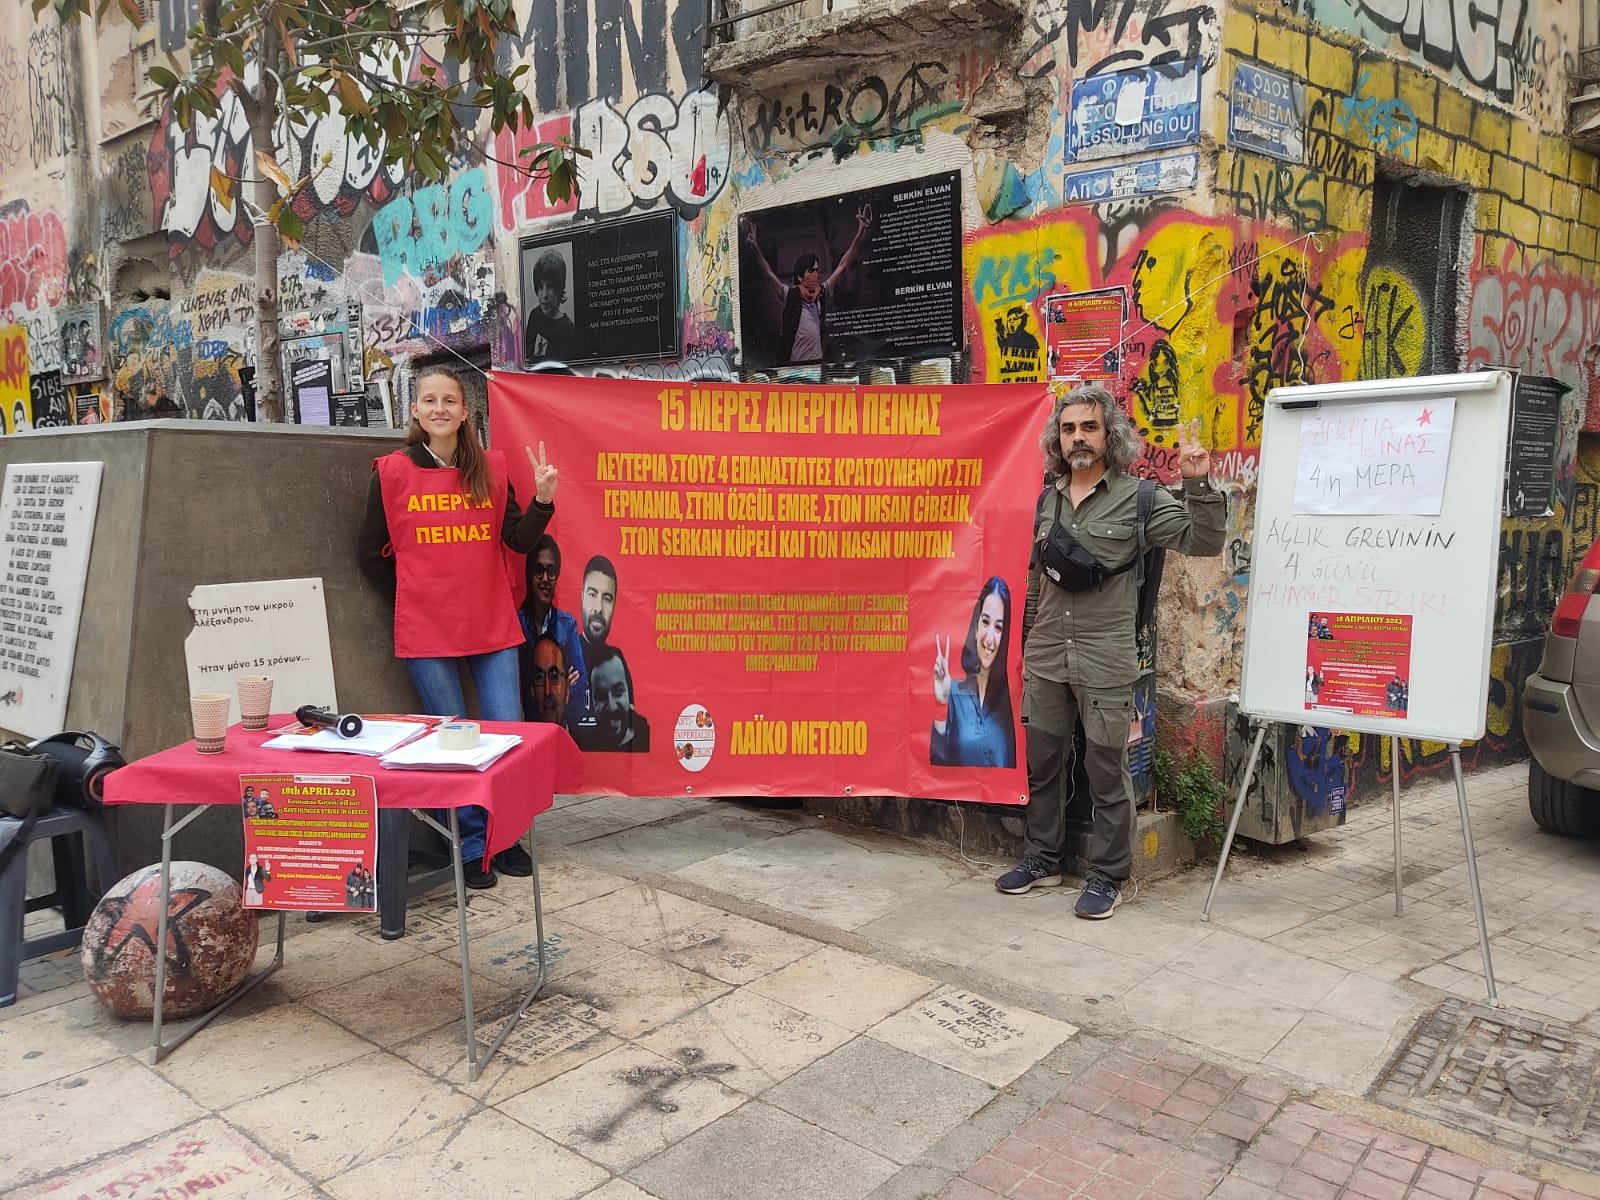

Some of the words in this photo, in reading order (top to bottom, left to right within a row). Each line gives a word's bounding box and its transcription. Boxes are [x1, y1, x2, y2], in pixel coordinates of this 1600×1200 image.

[1253, 73, 1290, 100] ΟΔΟΣ
[1070, 115, 1191, 148] MESSOLONGIOU
[924, 184, 951, 196] ELVAN
[895, 284, 924, 296] BERKİN
[926, 281, 952, 292] ELVAN
[658, 388, 684, 430] 15
[690, 390, 762, 433] ΜΕΡΕΣ
[765, 392, 858, 434] ΑΠΕΡΓΙΑ
[862, 393, 942, 436] ΠΕΙΝΑΣ
[596, 452, 668, 482] ΛΕΥΤΕΡΙΑ
[670, 454, 716, 484] ΣΤΟΥΣ
[718, 456, 728, 484] 4
[732, 456, 832, 486] ΕΠΑΝΑΣΤΑΤΕΣ
[834, 457, 954, 488] ΚΡΑΤΟΥΜΕΝΟΥΣ
[955, 459, 982, 488] ΣΤΗ
[1356, 463, 1416, 489] ΜΕΡΑ
[407, 493, 494, 512] ΑΠΕΡΓΑ
[604, 489, 683, 522] ΓΕΡΜΑΝΙΑ,
[686, 492, 724, 520] ΣΤΗΝ
[727, 488, 775, 522] ÖZGÜL
[778, 493, 821, 525] EMRE,
[824, 494, 862, 523] ΣΤΟΝ
[865, 494, 911, 523] IHSAN
[415, 524, 492, 544] ΠΕΙΝΑΣ
[620, 526, 658, 556] ΣΤΟΝ
[662, 528, 722, 556] SERKAN
[726, 524, 776, 558] KÜPELİ
[780, 530, 806, 558] ΚΑΙ
[808, 530, 838, 558] ΤΟΝ
[842, 530, 891, 558] HASAN
[1266, 518, 1332, 550] AÇLIK
[212, 604, 242, 616] μνήμη
[244, 604, 260, 612] του
[263, 600, 294, 612] μικρού
[848, 594, 866, 612] ΠΟΥ
[656, 614, 693, 631] ΑΠΕΡΓΙΑ
[695, 614, 726, 631] ΠΕΙΝΑΣ
[778, 614, 794, 632] ΣΤΙΣ
[854, 614, 890, 632] ΕΝΑΝΤΙΑ
[892, 614, 908, 632] ΣΤΟ
[1344, 616, 1384, 624] ΑΠΡΙΛΙΟΥ
[656, 634, 706, 652] ΦΑΣΙΣΤΙΚΟ
[708, 634, 736, 652] ΝΟΜΟ
[738, 634, 756, 652] ΤΟΥ
[757, 634, 794, 652] ΤΡΟΜΟΥ
[797, 634, 813, 652] 129
[832, 634, 849, 652] ΤΟΥ
[850, 634, 908, 652] ΓΕΡΜΑΝΙΚΟΥ
[228, 661, 250, 672] μόνο
[254, 658, 265, 667] 15
[268, 655, 310, 667] χρόνων...
[746, 654, 820, 672] ΙΜΠΕΡΙΑΛΙΣΜΟΥ.
[730, 714, 788, 756] ΛΑΪΚΟ
[791, 720, 868, 756] ΜΕΤΩΠΟ
[282, 786, 300, 795] 18th
[302, 786, 334, 796] APRIL
[335, 788, 356, 796] 2023
